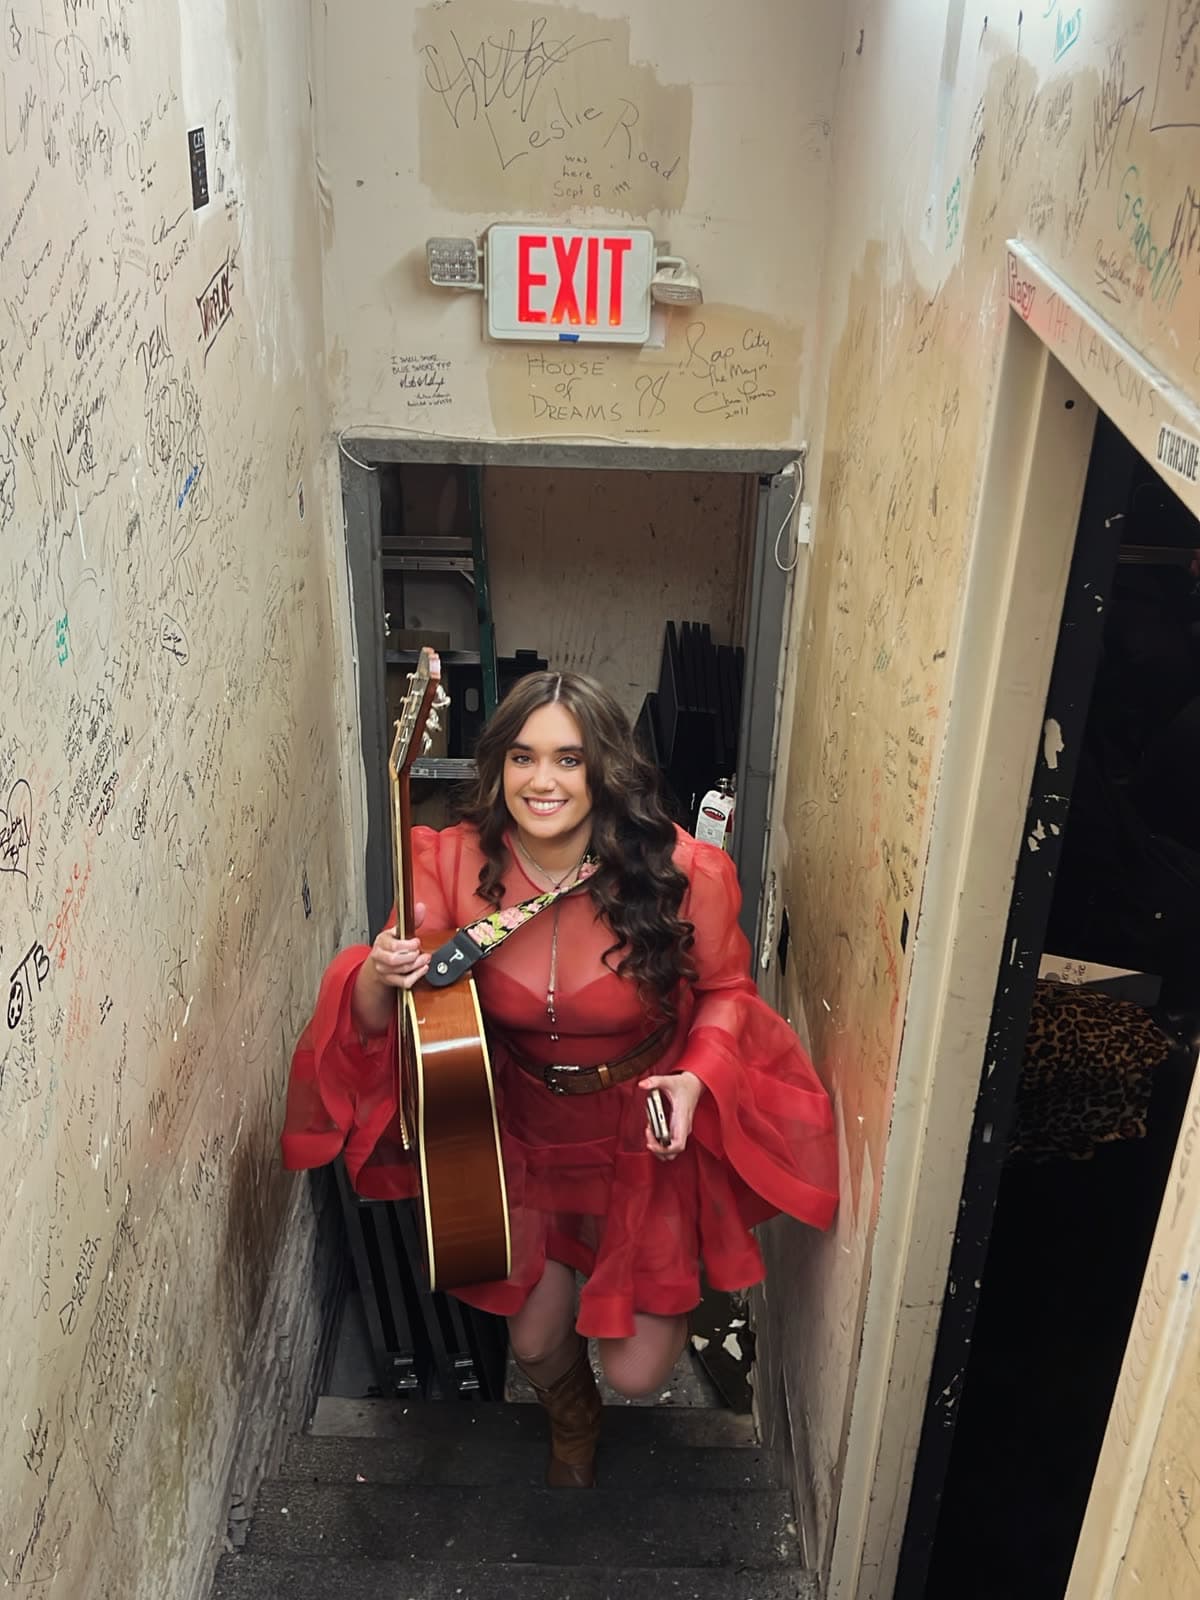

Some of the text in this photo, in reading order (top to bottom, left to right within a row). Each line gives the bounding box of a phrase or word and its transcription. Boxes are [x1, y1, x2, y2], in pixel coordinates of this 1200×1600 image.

[485, 88, 680, 180] Leslie Road
[565, 155, 588, 164] was
[563, 165, 593, 179] here
[553, 181, 584, 198] Sept
[593, 184, 601, 198] 8
[518, 235, 632, 325] EXIT
[526, 352, 605, 376] HOUSE
[555, 378, 582, 402] of
[528, 394, 622, 421] DREAMS
